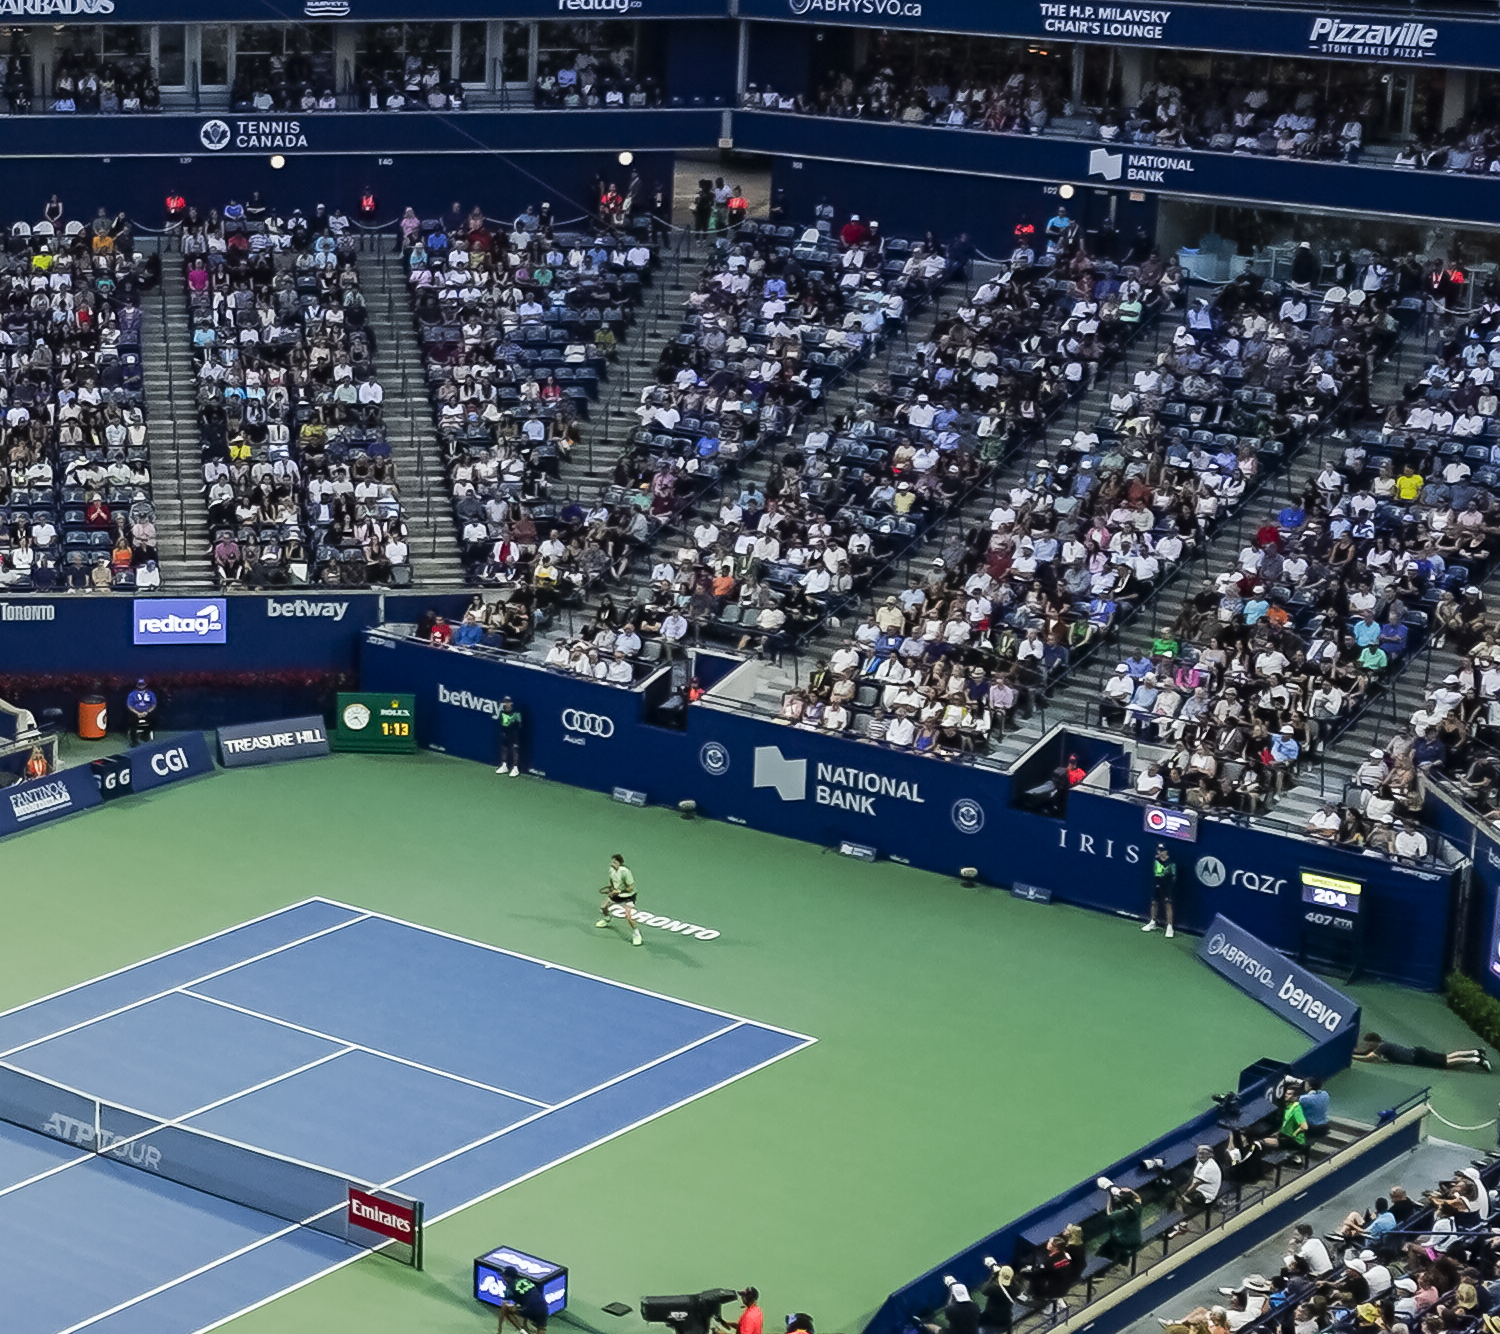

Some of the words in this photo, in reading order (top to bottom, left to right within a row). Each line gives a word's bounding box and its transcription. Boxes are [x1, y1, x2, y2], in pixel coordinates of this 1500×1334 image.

[1040, 3, 1067, 17] THE
[1069, 4, 1095, 19] H.P.
[1099, 6, 1171, 25] MILAVSKY
[1044, 18, 1100, 35] CHAIR'S
[1103, 21, 1163, 40] LOUNGE
[1309, 17, 1439, 48] Pizzaville
[237, 121, 301, 134] TENNIS
[236, 134, 308, 148] CANADA
[1128, 154, 1194, 172] NATIONAL
[1127, 168, 1165, 183] BANK
[0, 601, 56, 622] TORONTO
[266, 598, 350, 622] betway
[381, 721, 410, 736] 1:13
[223, 732, 297, 754] TREASURE
[295, 728, 326, 746] HILL
[150, 747, 190, 776] CGI
[817, 762, 925, 803] NATIONAL
[816, 785, 878, 817] BANK
[1058, 827, 1140, 864] IRIS
[1231, 868, 1288, 896] razr
[1313, 888, 1349, 908] 204
[1304, 912, 1334, 926] 407
[1277, 974, 1343, 1032] beneva
[43, 1110, 95, 1144] ATP
[96, 1127, 163, 1171] TOUR
[351, 1198, 411, 1234] Emirates
